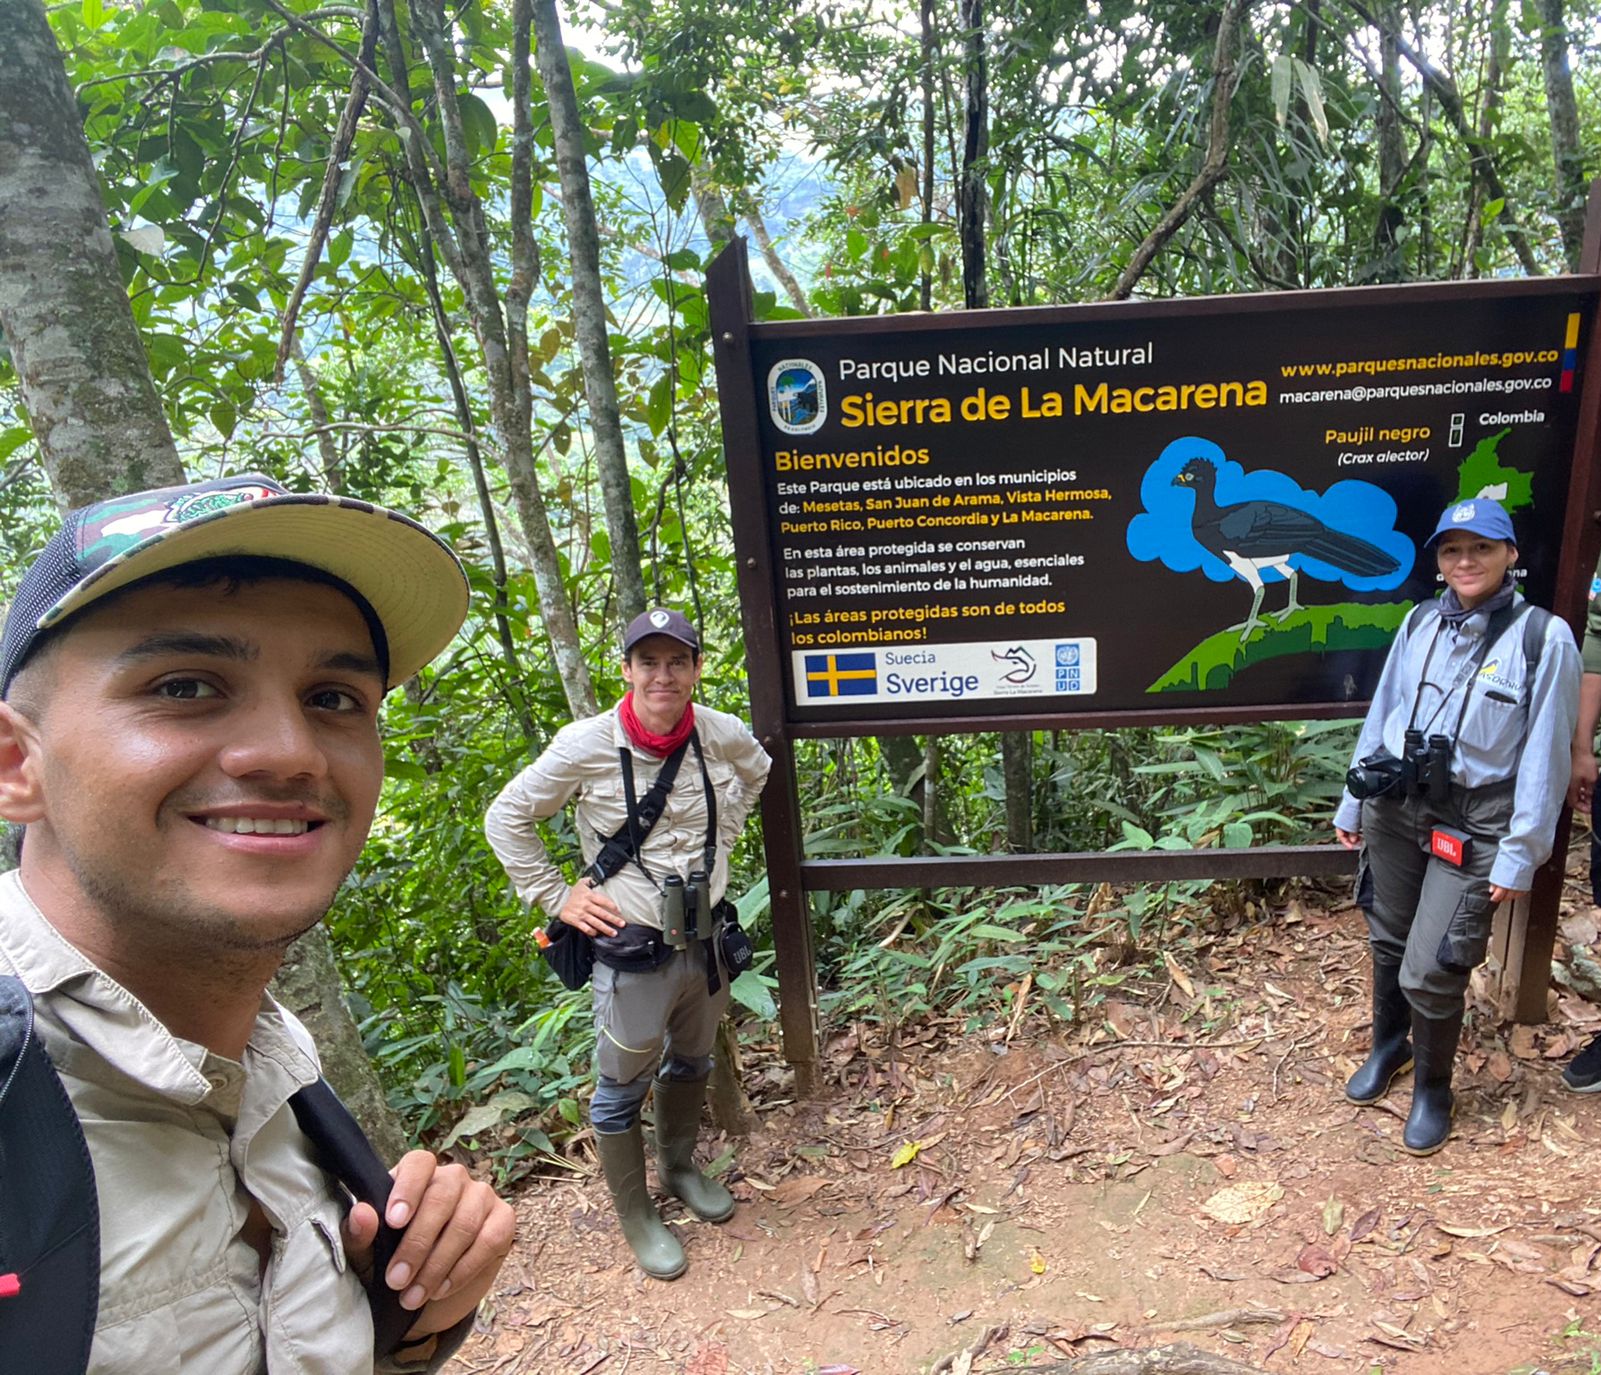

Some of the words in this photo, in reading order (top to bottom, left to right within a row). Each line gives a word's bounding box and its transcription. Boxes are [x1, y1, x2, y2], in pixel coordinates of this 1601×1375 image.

[839, 360, 930, 382] Parque
[938, 348, 1049, 375] Nacional
[1058, 342, 1152, 368] Natural
[1280, 349, 1559, 378] www.parquesnacionales.gov.co
[1280, 377, 1553, 404] macarena@parquesnacionales.gov.co
[840, 392, 951, 427] Sierra
[959, 388, 1011, 421] de
[1020, 387, 1062, 418] La
[1073, 380, 1267, 415] Macarena
[1478, 409, 1544, 425] Colombia
[1324, 427, 1374, 445] Paujil
[1378, 427, 1430, 443] negro
[775, 446, 929, 471] Bienvenidos
[1337, 453, 1374, 466] (Crax
[1375, 448, 1429, 462] alector)
[777, 483, 807, 495] Este
[809, 481, 860, 494] Parque
[862, 477, 891, 491] está
[894, 475, 952, 489] ubicado
[953, 476, 972, 486] en
[975, 473, 996, 485] los
[998, 469, 1077, 484] municipios
[778, 502, 800, 514] de:
[802, 500, 863, 513] Mesetas,
[865, 498, 892, 510] San
[894, 497, 929, 508] Juan
[931, 494, 951, 507] de
[952, 494, 1004, 506] Arama,
[1005, 491, 1042, 503] Vista
[1044, 489, 1112, 501] Hermosa,
[780, 521, 827, 533] Puerto
[830, 519, 864, 531] Rico,
[866, 517, 914, 529] Puerto
[915, 512, 989, 527] Concordia
[990, 514, 1000, 526] y
[1001, 512, 1019, 523] La
[1020, 510, 1094, 522] Macarena.
[783, 548, 801, 559] En
[804, 547, 832, 558] esta
[835, 545, 865, 557] área
[868, 541, 935, 558] protegida
[937, 543, 953, 552] se
[955, 539, 1025, 551] conservan
[785, 568, 803, 578] las
[806, 565, 859, 580] plantas,
[861, 563, 881, 575] los
[883, 560, 946, 574] animales
[947, 562, 957, 574] y
[958, 558, 971, 571] el
[974, 559, 1011, 572] agua,
[1013, 553, 1084, 568] esenciales
[786, 587, 816, 599] para
[819, 584, 832, 596] el
[834, 580, 931, 595] sostenimiento
[932, 578, 952, 590] de
[953, 577, 966, 590] la
[969, 573, 1052, 589] humanidad.
[789, 612, 820, 626] ¡Las
[823, 609, 867, 623] áreas
[870, 605, 958, 623] protegidas
[961, 605, 990, 616] son
[993, 602, 1016, 615] de
[1018, 600, 1065, 614] todos
[791, 632, 814, 644] los
[816, 627, 926, 644] colombianos!
[885, 650, 936, 665] Suecia
[886, 670, 979, 697] Sverige
